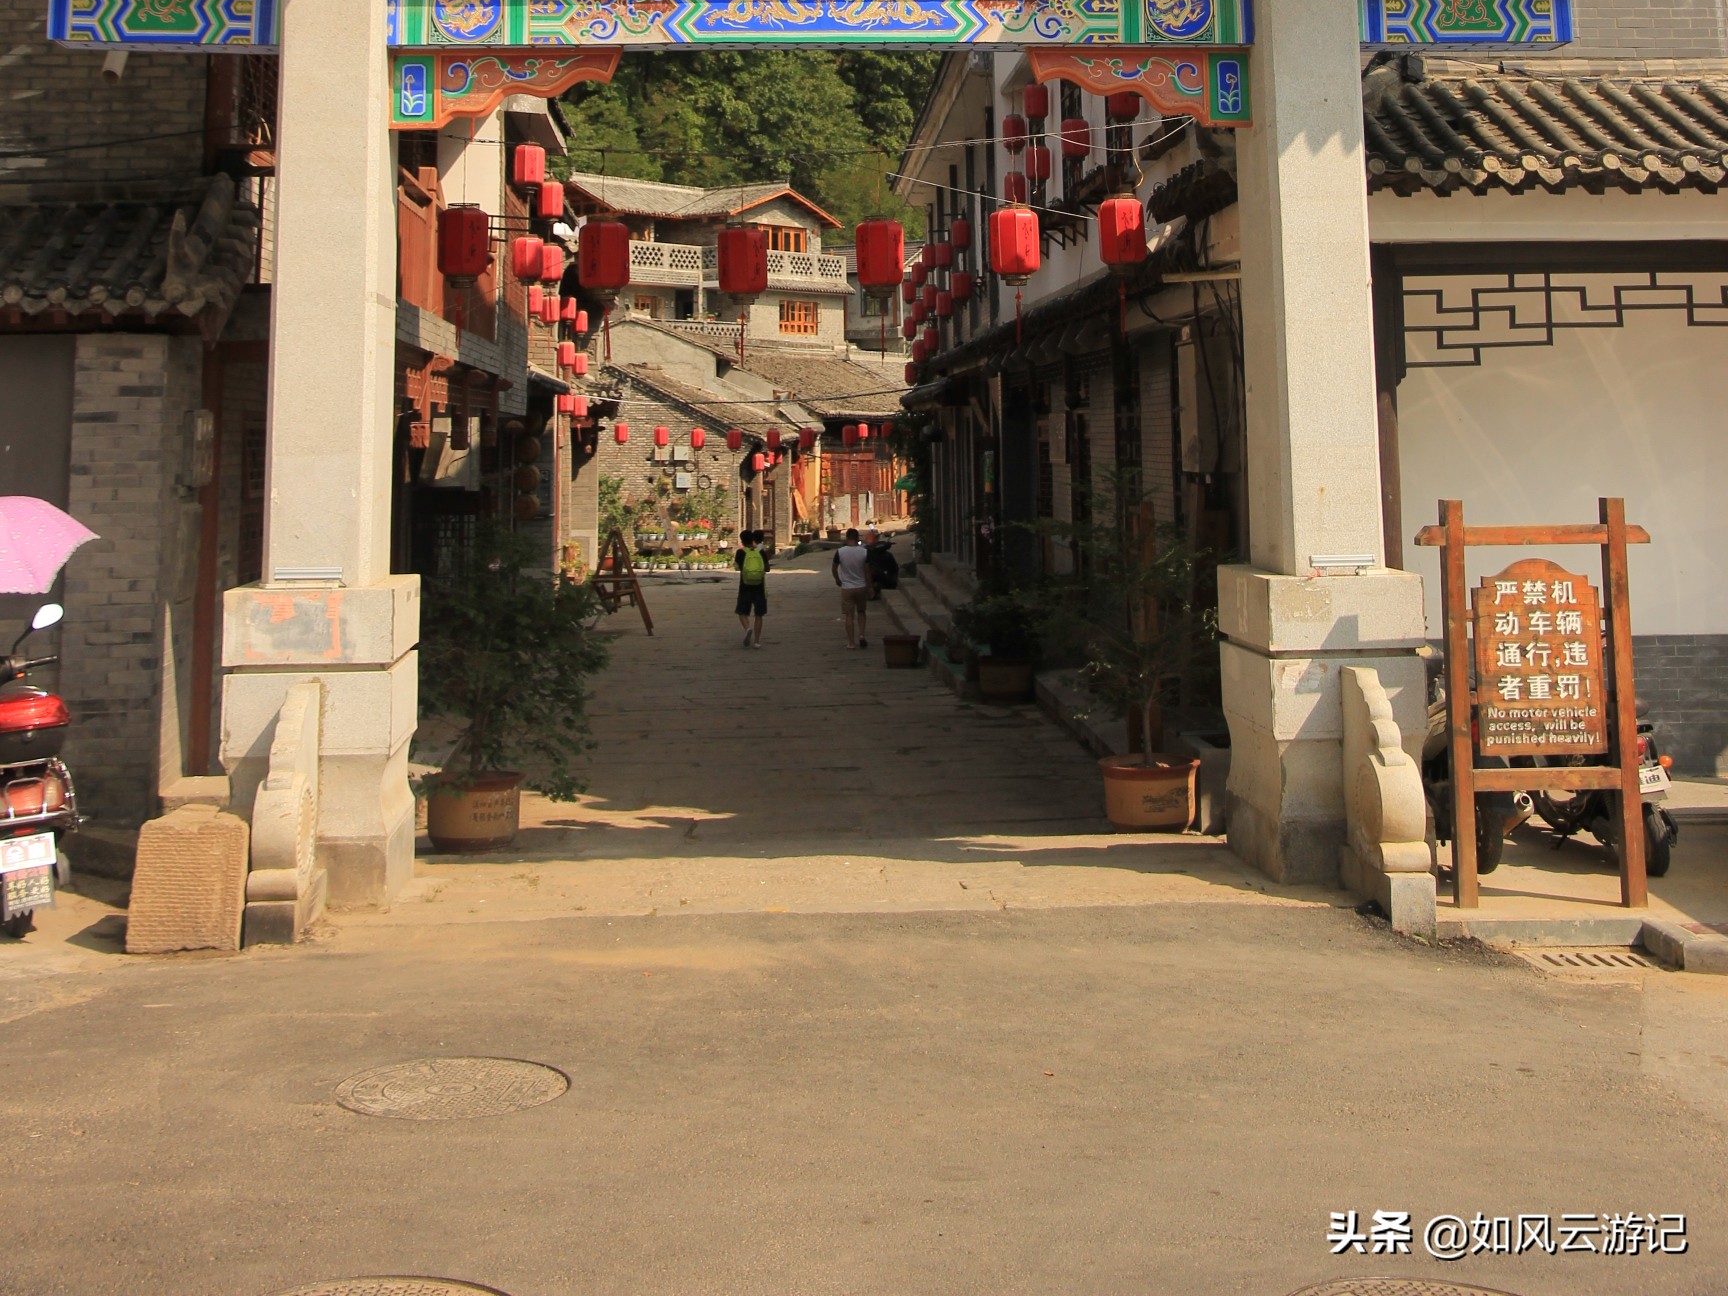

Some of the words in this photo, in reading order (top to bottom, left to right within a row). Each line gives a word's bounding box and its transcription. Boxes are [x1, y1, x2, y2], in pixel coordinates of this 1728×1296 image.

[1494, 580, 1577, 605] 严禁机
[1495, 610, 1583, 635] 动车辆
[1487, 707, 1506, 718] No
[1509, 708, 1548, 718] motor
[1551, 706, 1597, 717] vehicle
[1488, 721, 1536, 732] access,
[1543, 719, 1567, 730] will
[1570, 719, 1586, 730] be
[1486, 732, 1546, 746] punished
[1549, 731, 1600, 745] heavily!
